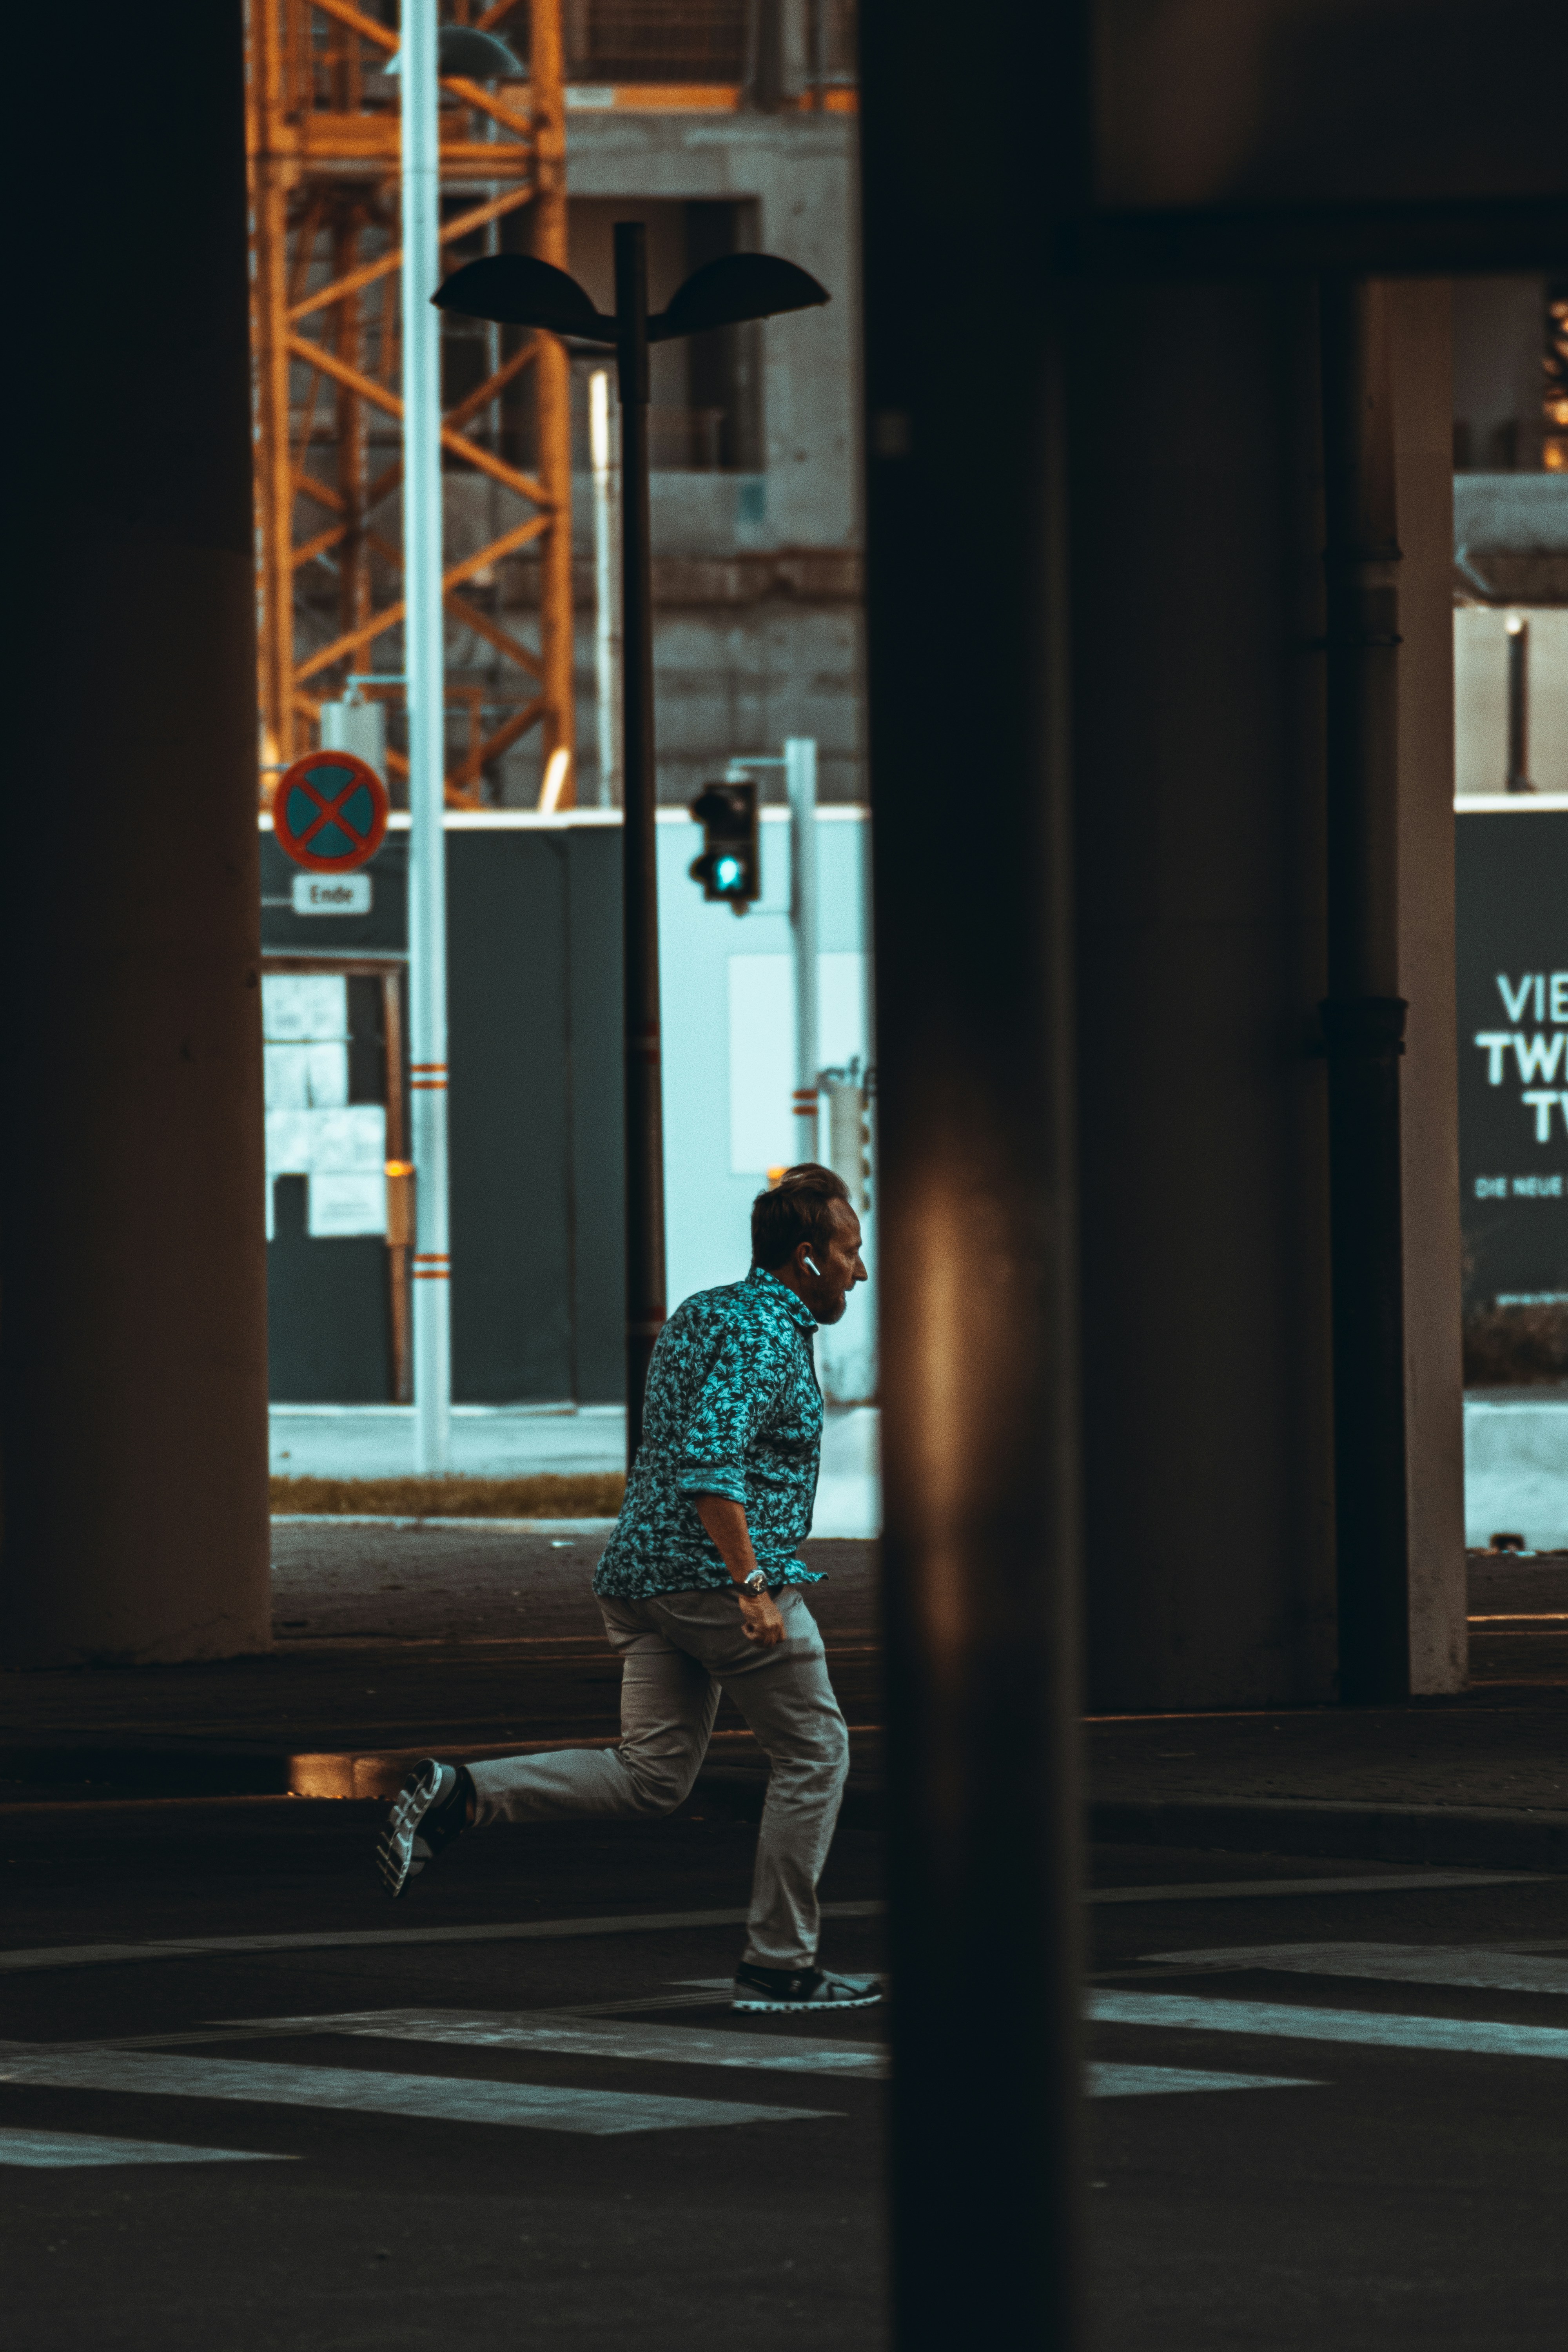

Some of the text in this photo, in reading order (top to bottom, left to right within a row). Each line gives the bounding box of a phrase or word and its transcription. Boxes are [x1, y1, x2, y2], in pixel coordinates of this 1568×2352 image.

[311, 884, 353, 904] Ende
[1475, 1032, 1568, 1084] TW
[1522, 1091, 1568, 1142] T
[1475, 1175, 1563, 1197] DIE NEUE
